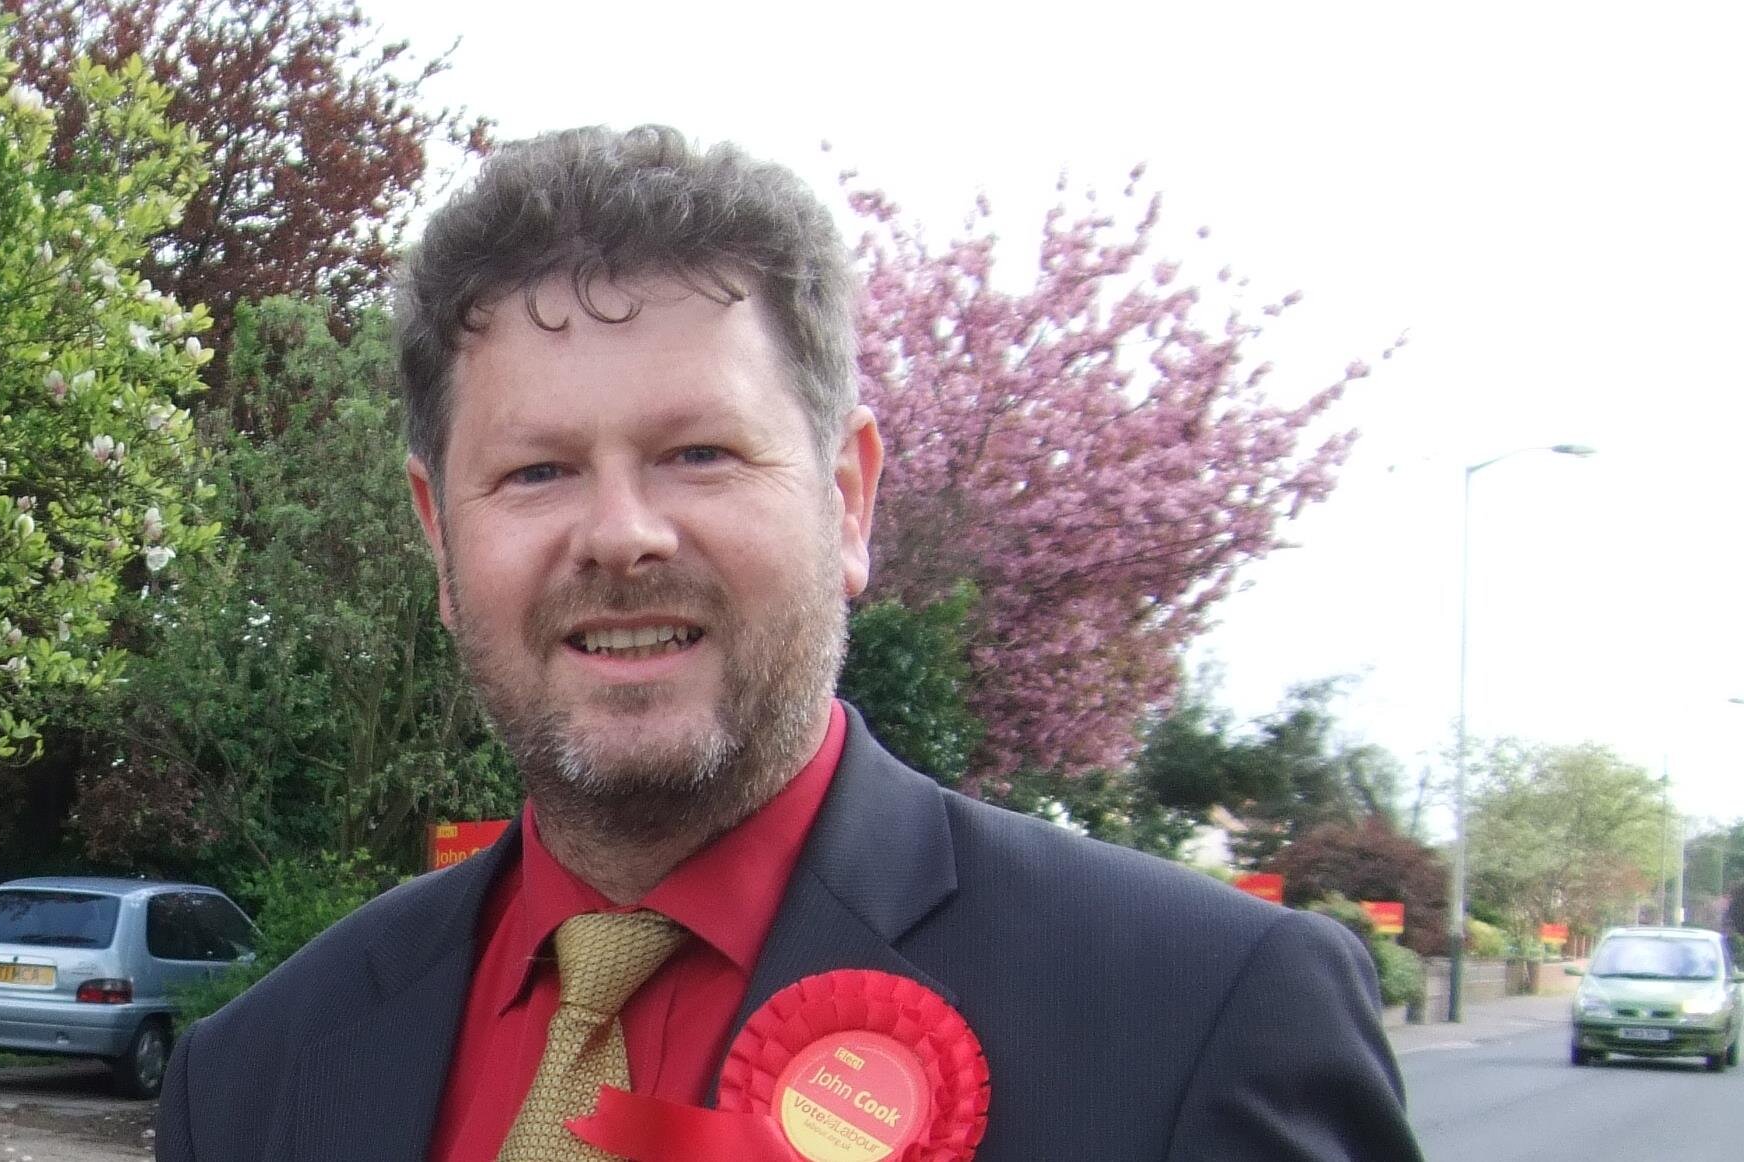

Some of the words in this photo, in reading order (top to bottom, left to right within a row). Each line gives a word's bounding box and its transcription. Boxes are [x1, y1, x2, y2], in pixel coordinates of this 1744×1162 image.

[793, 1095, 825, 1122] Vote
[833, 1119, 882, 1153] Labour
[808, 1065, 853, 1100] John
[853, 1090, 903, 1128] Cook
